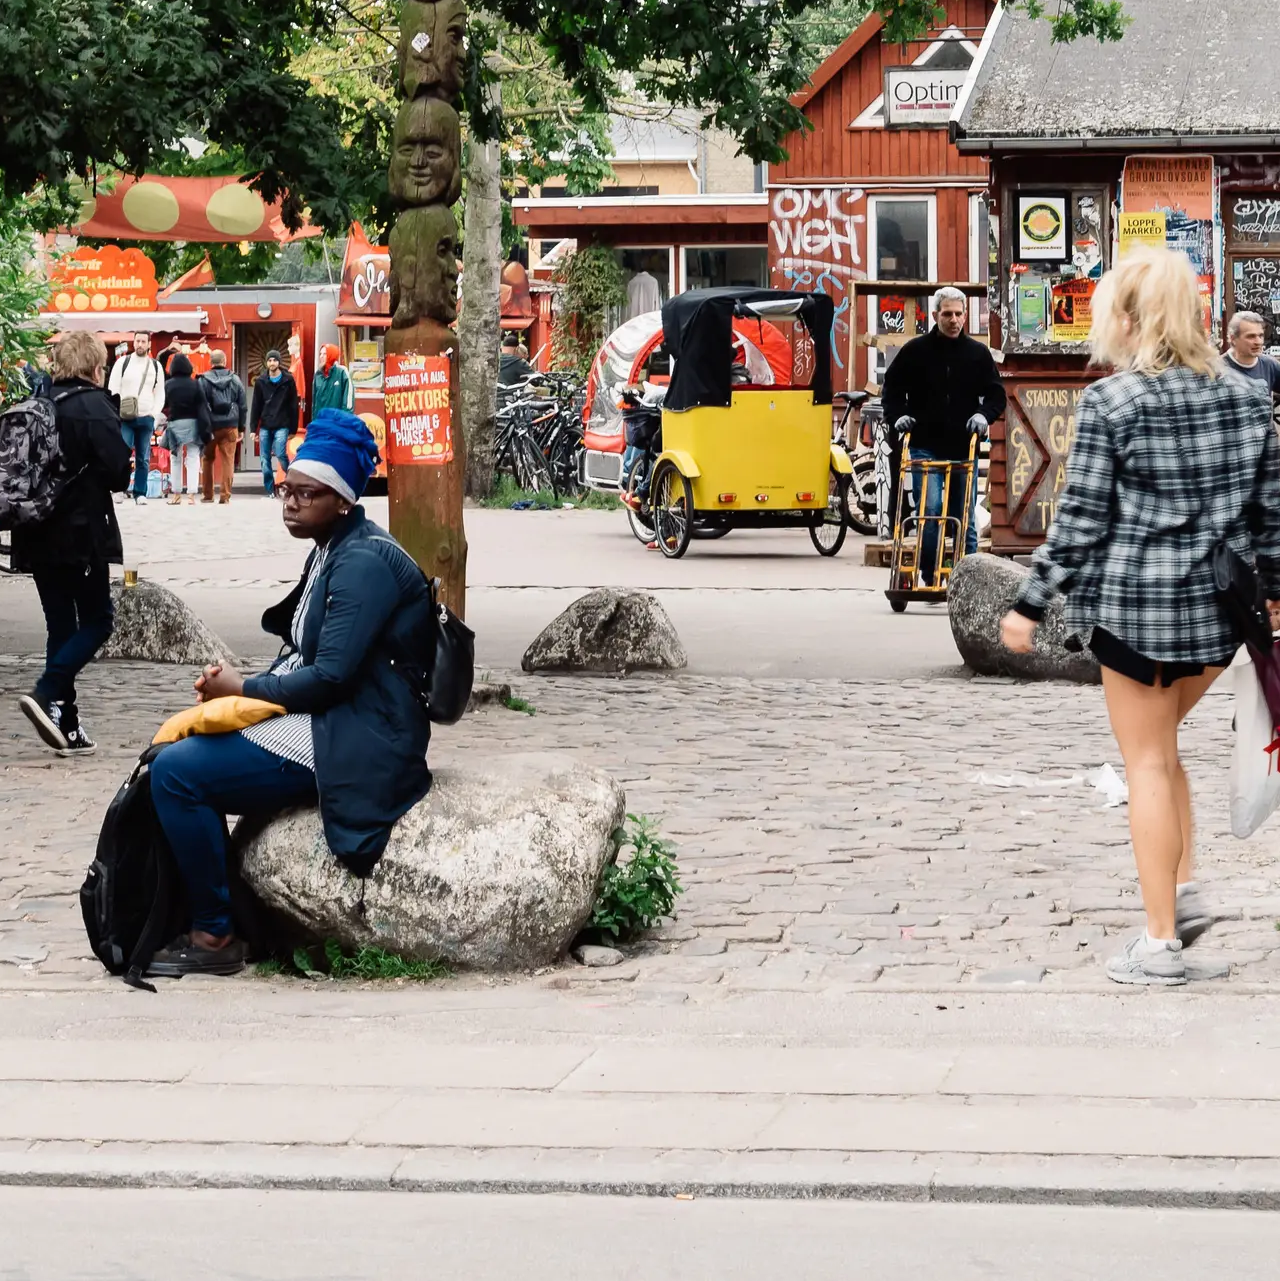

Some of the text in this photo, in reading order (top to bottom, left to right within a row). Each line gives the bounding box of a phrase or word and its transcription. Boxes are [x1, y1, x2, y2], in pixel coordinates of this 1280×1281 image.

[1129, 171, 1206, 182] GRUNDLOVSDAG
[1122, 227, 1162, 235] MARKED
[109, 294, 150, 308] Boden
[410, 373, 419, 385] D.
[420, 372, 428, 384] 14
[430, 371, 448, 384] AUG.
[384, 388, 449, 414] SPECKTORS
[1026, 389, 1068, 408] STADENS
[390, 413, 440, 434] AL AGAMI &
[395, 428, 434, 447] PHASE 5
